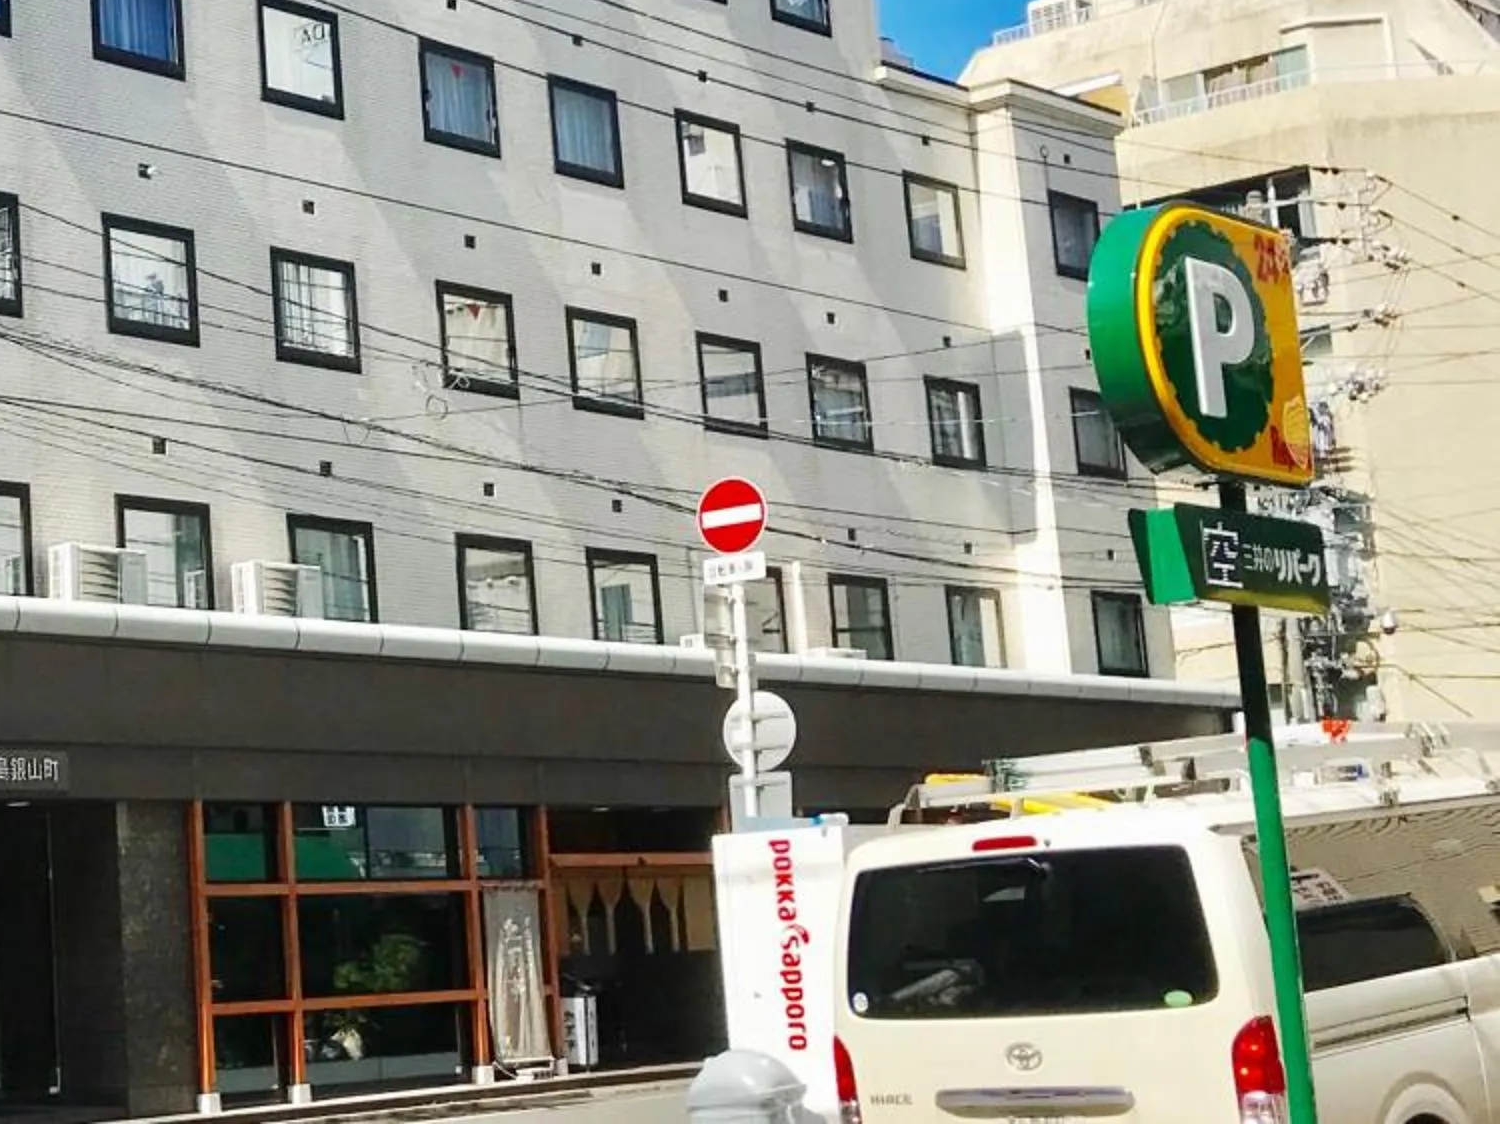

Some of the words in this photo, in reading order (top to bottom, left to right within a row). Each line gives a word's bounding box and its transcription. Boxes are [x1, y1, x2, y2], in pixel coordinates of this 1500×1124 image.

[1184, 256, 1255, 419] P
[1203, 521, 1244, 588] 空
[1242, 543, 1321, 586] 三井のリパーク
